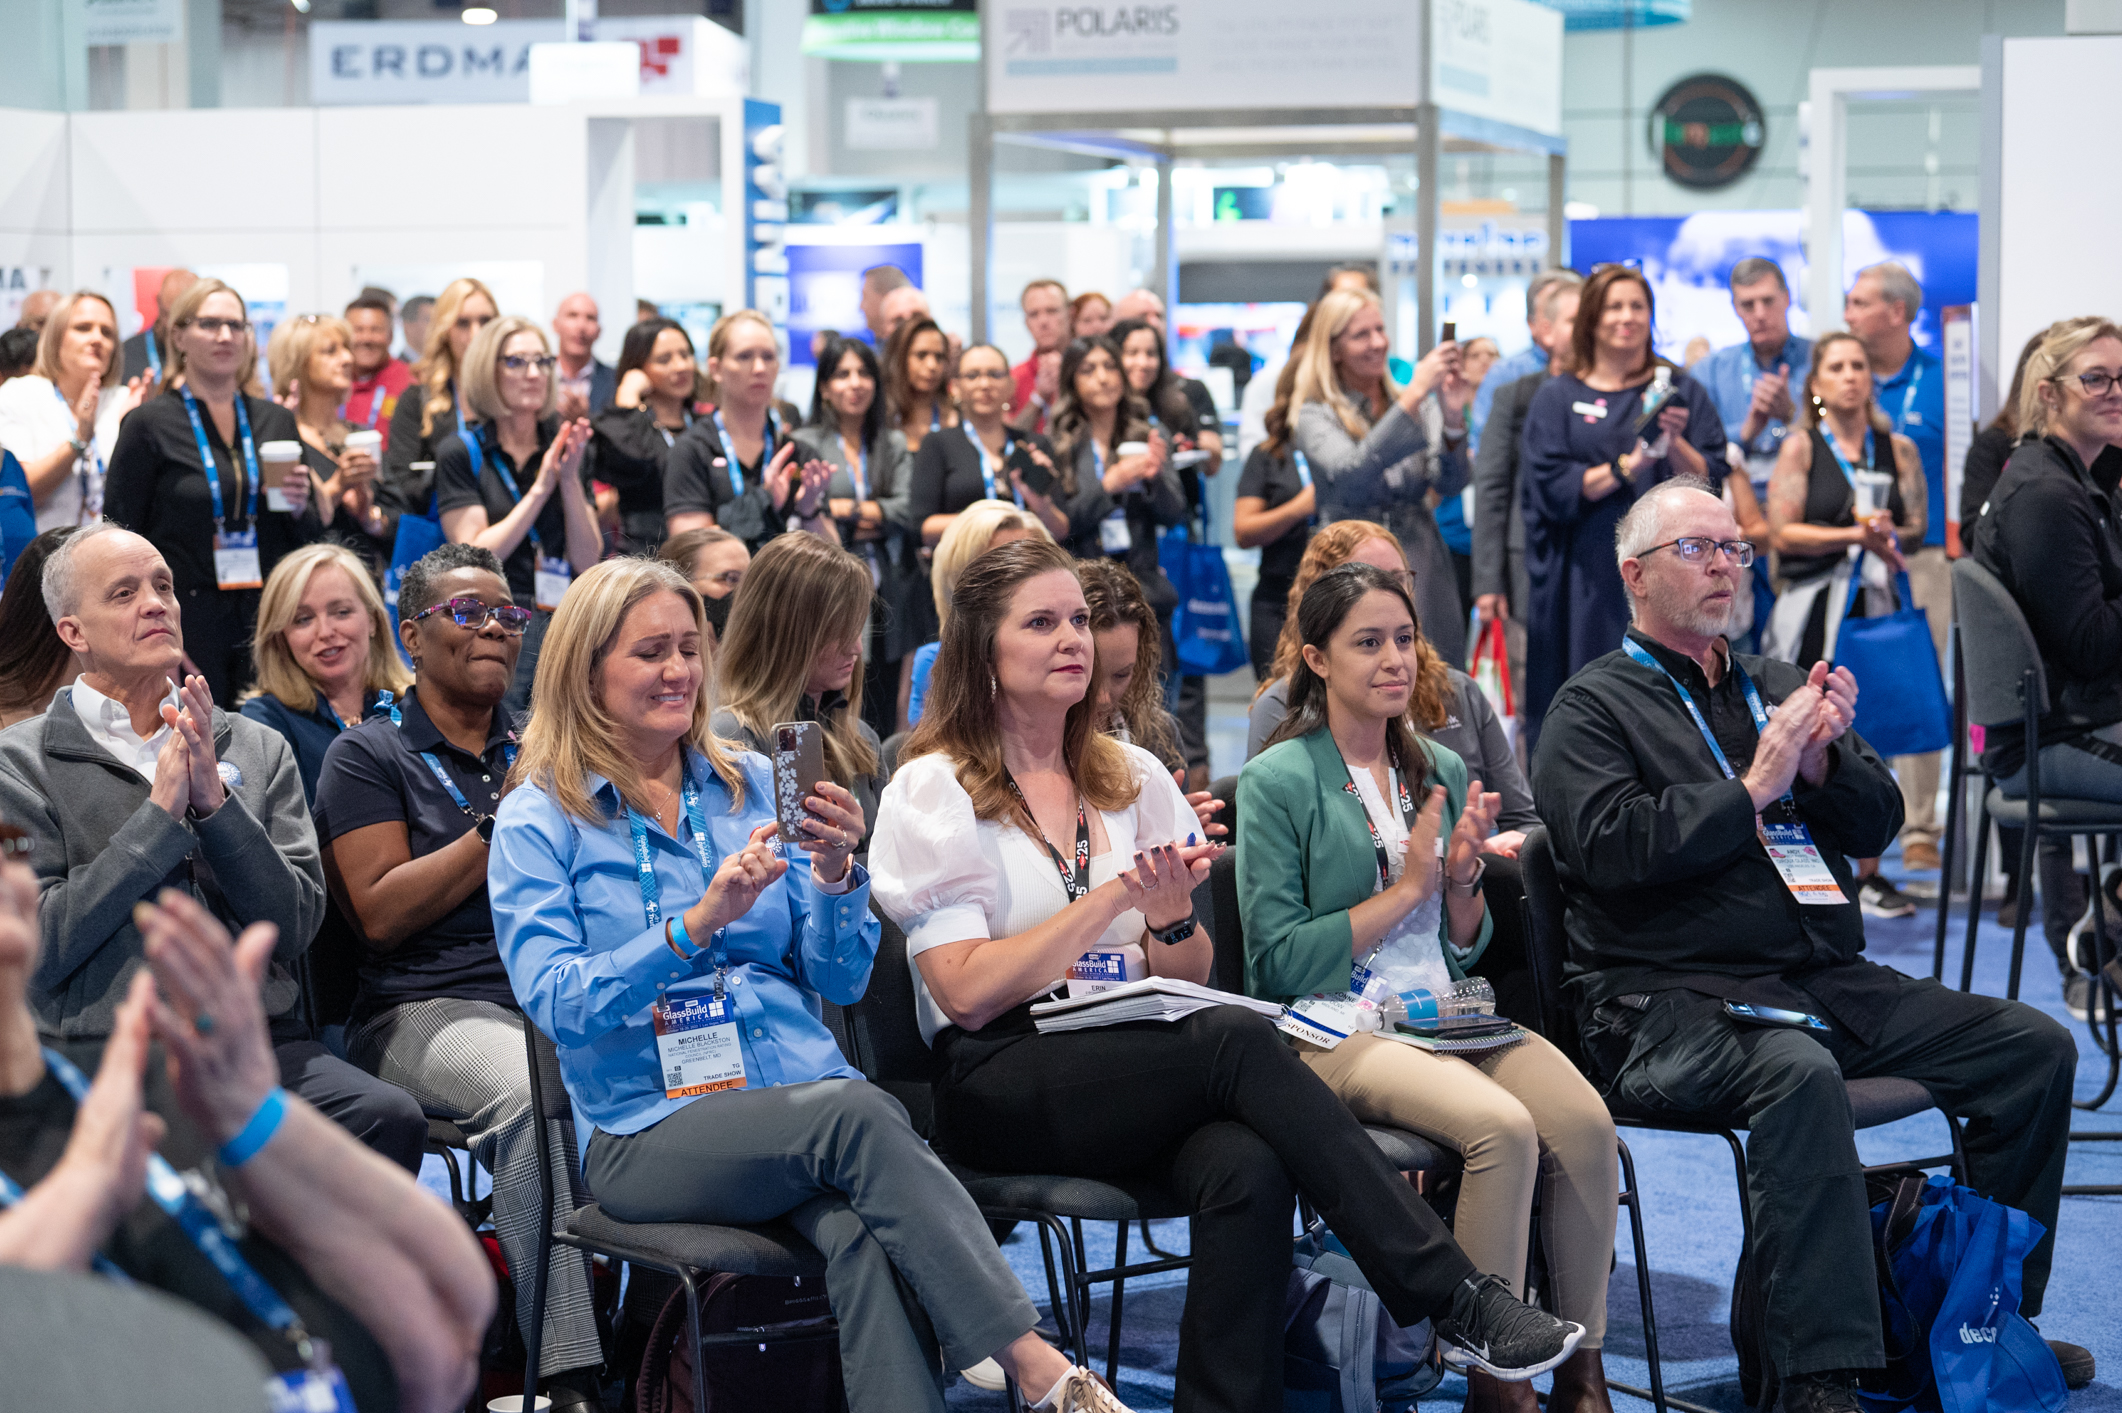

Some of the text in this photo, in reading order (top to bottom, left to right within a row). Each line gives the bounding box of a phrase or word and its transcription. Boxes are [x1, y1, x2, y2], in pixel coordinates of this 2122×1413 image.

[1055, 4, 1180, 38] POLARIS
[1351, 970, 1369, 984] Build
[662, 1004, 708, 1021] GlassBuild
[664, 1013, 709, 1026] AMERICA
[678, 1031, 718, 1045] MICHELLE
[1286, 1022, 1331, 1044] SPONSOR
[667, 1037, 731, 1053] MICHELLE BLACKSTON
[703, 1069, 742, 1081] TRADE SHOW
[681, 1080, 734, 1097] ATTENDEE
